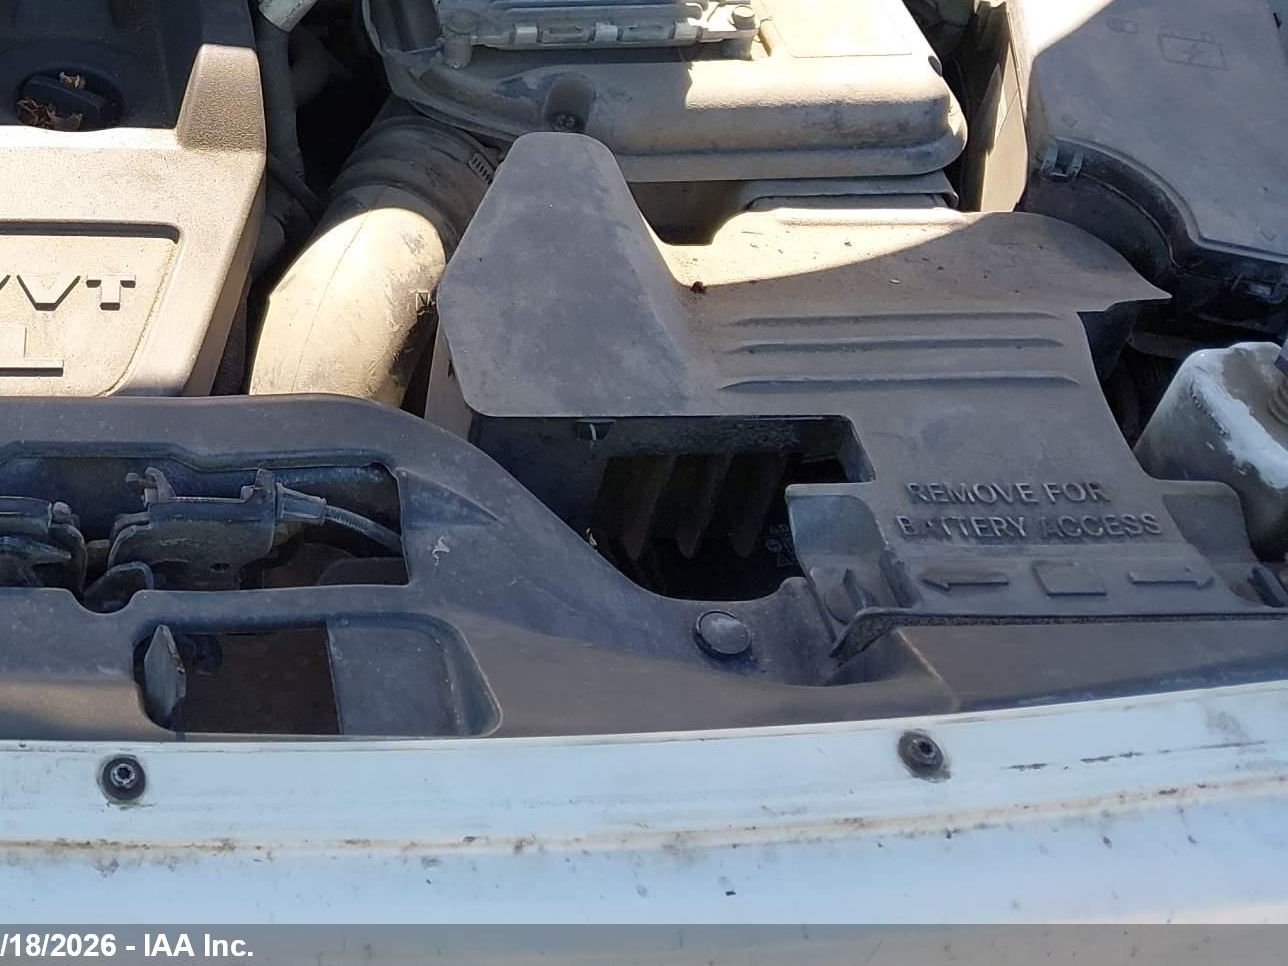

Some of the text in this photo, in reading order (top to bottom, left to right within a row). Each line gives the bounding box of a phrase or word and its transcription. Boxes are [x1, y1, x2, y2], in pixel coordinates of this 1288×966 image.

[907, 481, 1111, 505] REMOVE FOR
[896, 512, 1162, 538] BATTERY ACCESS
